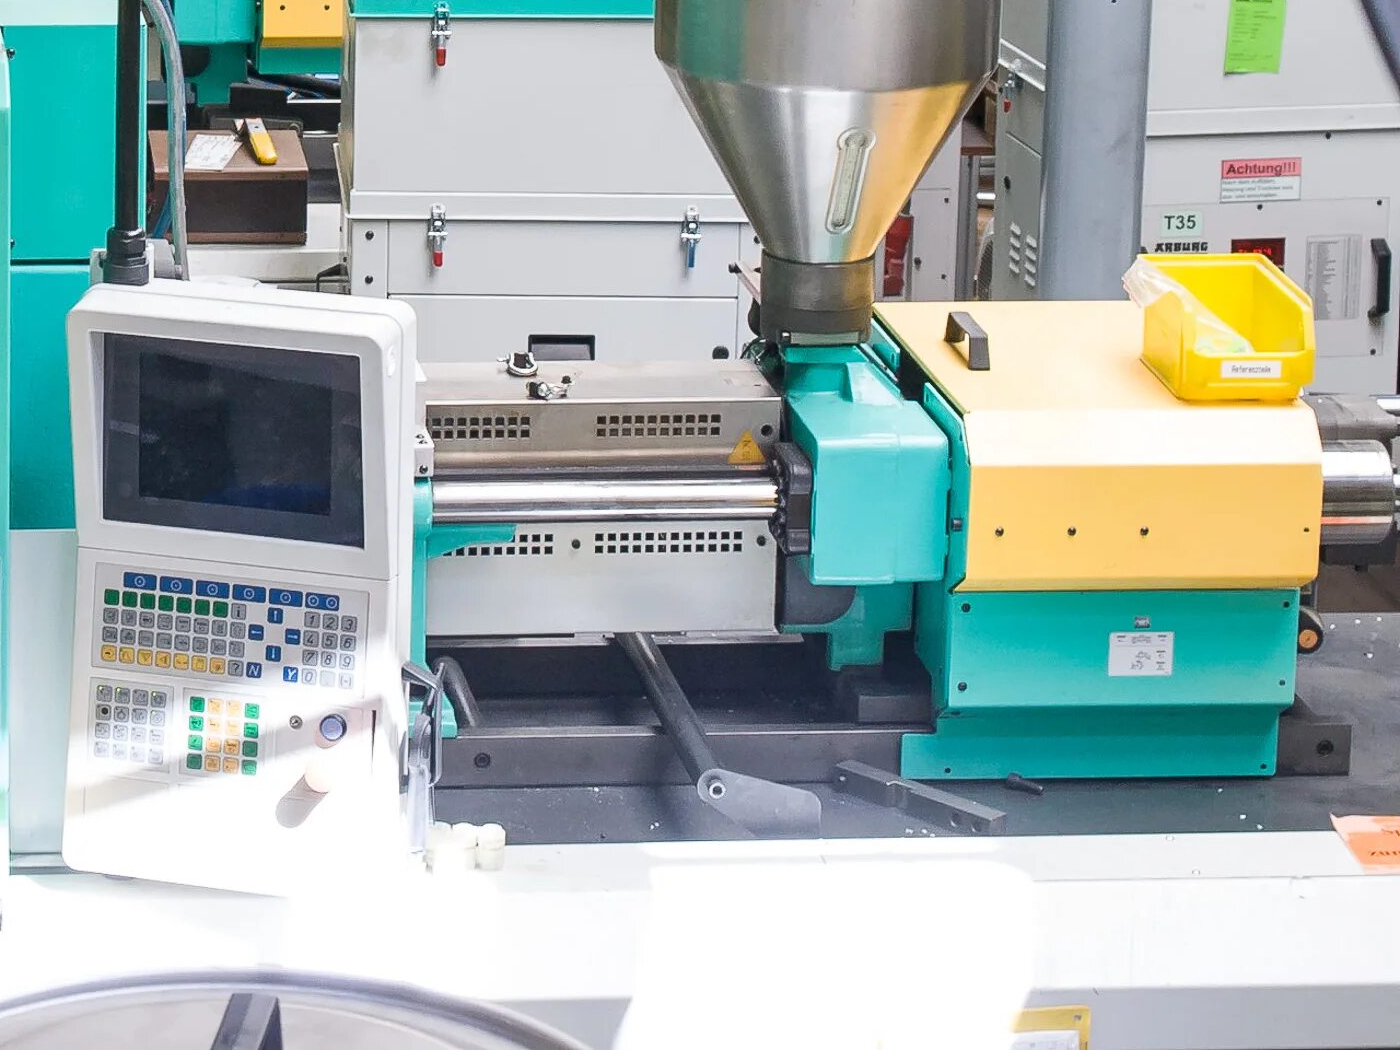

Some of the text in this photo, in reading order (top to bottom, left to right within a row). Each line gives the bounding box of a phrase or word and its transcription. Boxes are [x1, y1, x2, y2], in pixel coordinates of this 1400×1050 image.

[1226, 161, 1296, 176] Achtung!!!
[1164, 215, 1196, 230] T35
[1155, 242, 1208, 253] ARBURG
[308, 615, 355, 631] 1 2 3
[306, 634, 353, 650] 4 5 6
[305, 651, 316, 665] 7
[324, 654, 333, 666] 8
[249, 664, 260, 677] N
[286, 668, 296, 681] Y
